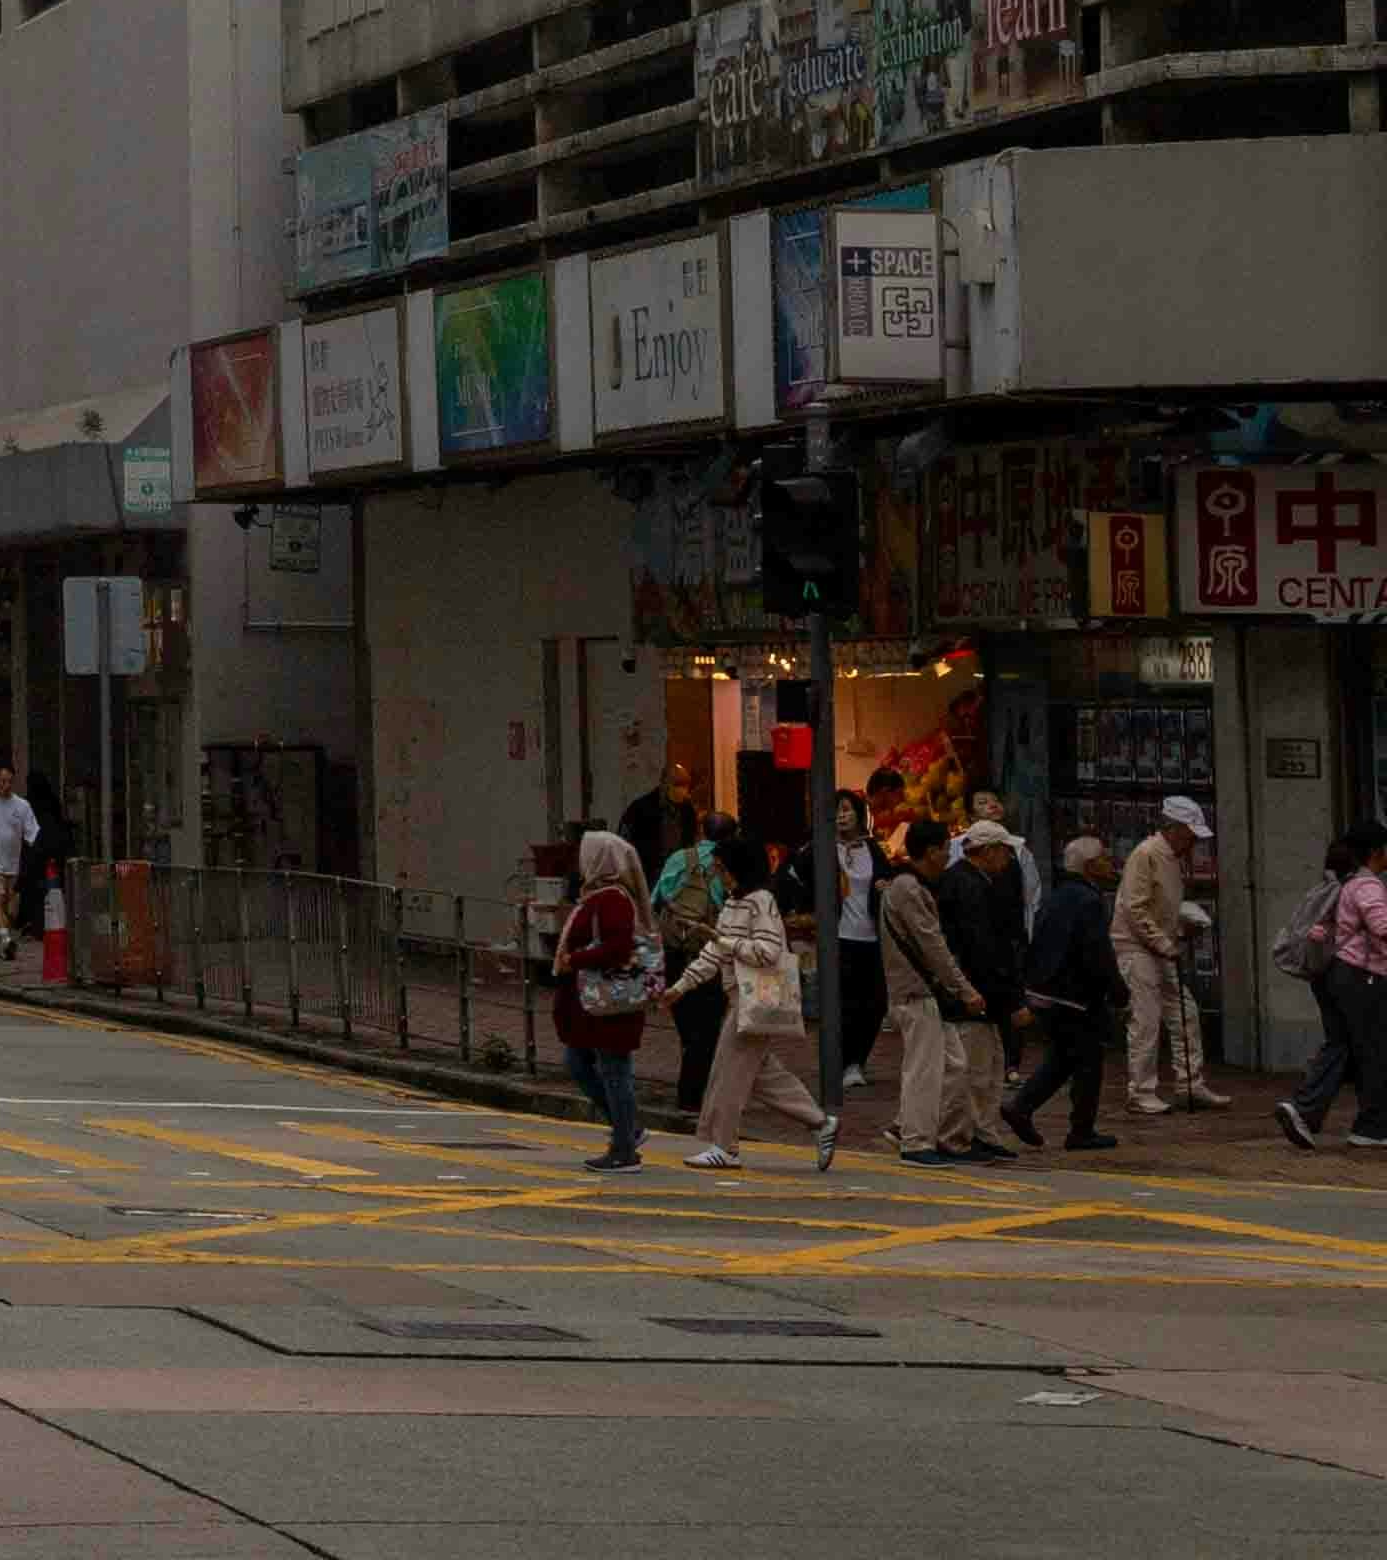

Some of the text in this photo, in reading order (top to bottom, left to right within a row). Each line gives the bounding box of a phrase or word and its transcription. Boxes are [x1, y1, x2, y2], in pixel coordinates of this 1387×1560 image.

[787, 32, 866, 100] educate
[880, 17, 965, 70] exhibition
[870, 249, 933, 274] SPACE
[630, 303, 709, 402] Enjoy
[1277, 470, 1377, 575] 中
